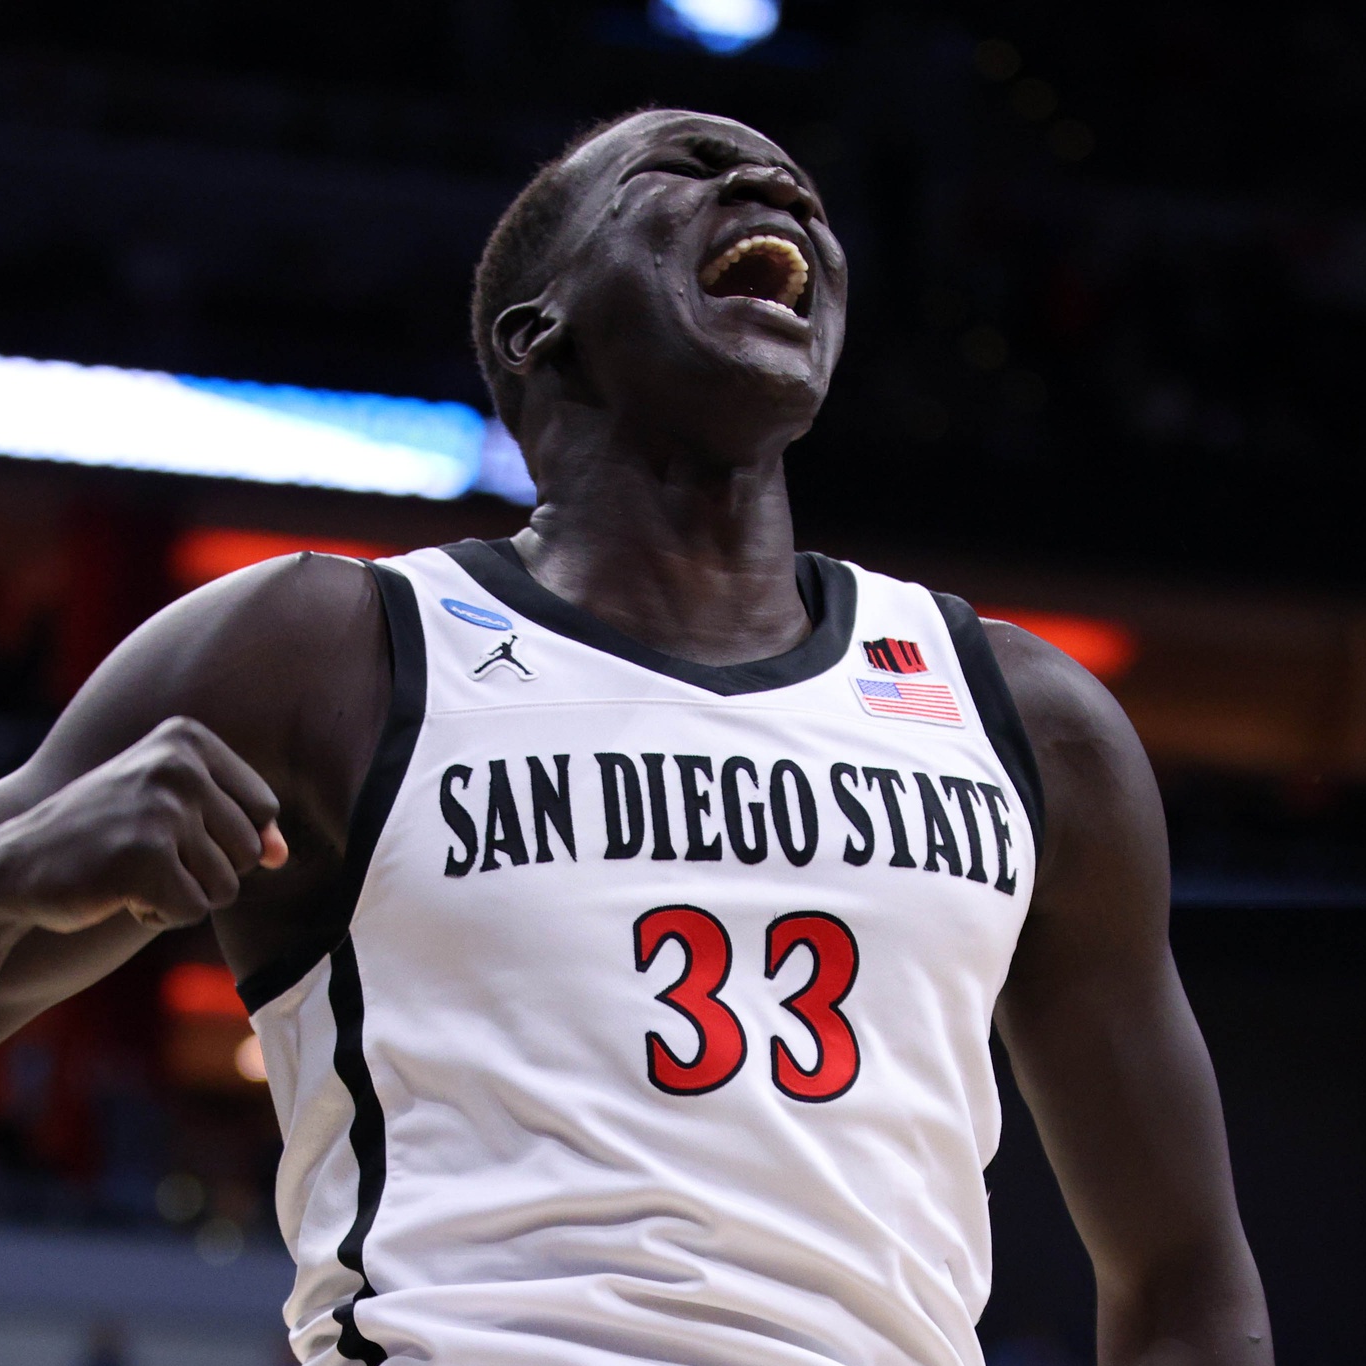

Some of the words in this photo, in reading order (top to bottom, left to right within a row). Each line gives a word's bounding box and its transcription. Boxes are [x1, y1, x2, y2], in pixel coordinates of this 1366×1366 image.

[439, 754, 577, 878] SAN
[593, 752, 819, 868] DIEGO
[830, 762, 1018, 897] STATE
[633, 904, 860, 1103] 33
